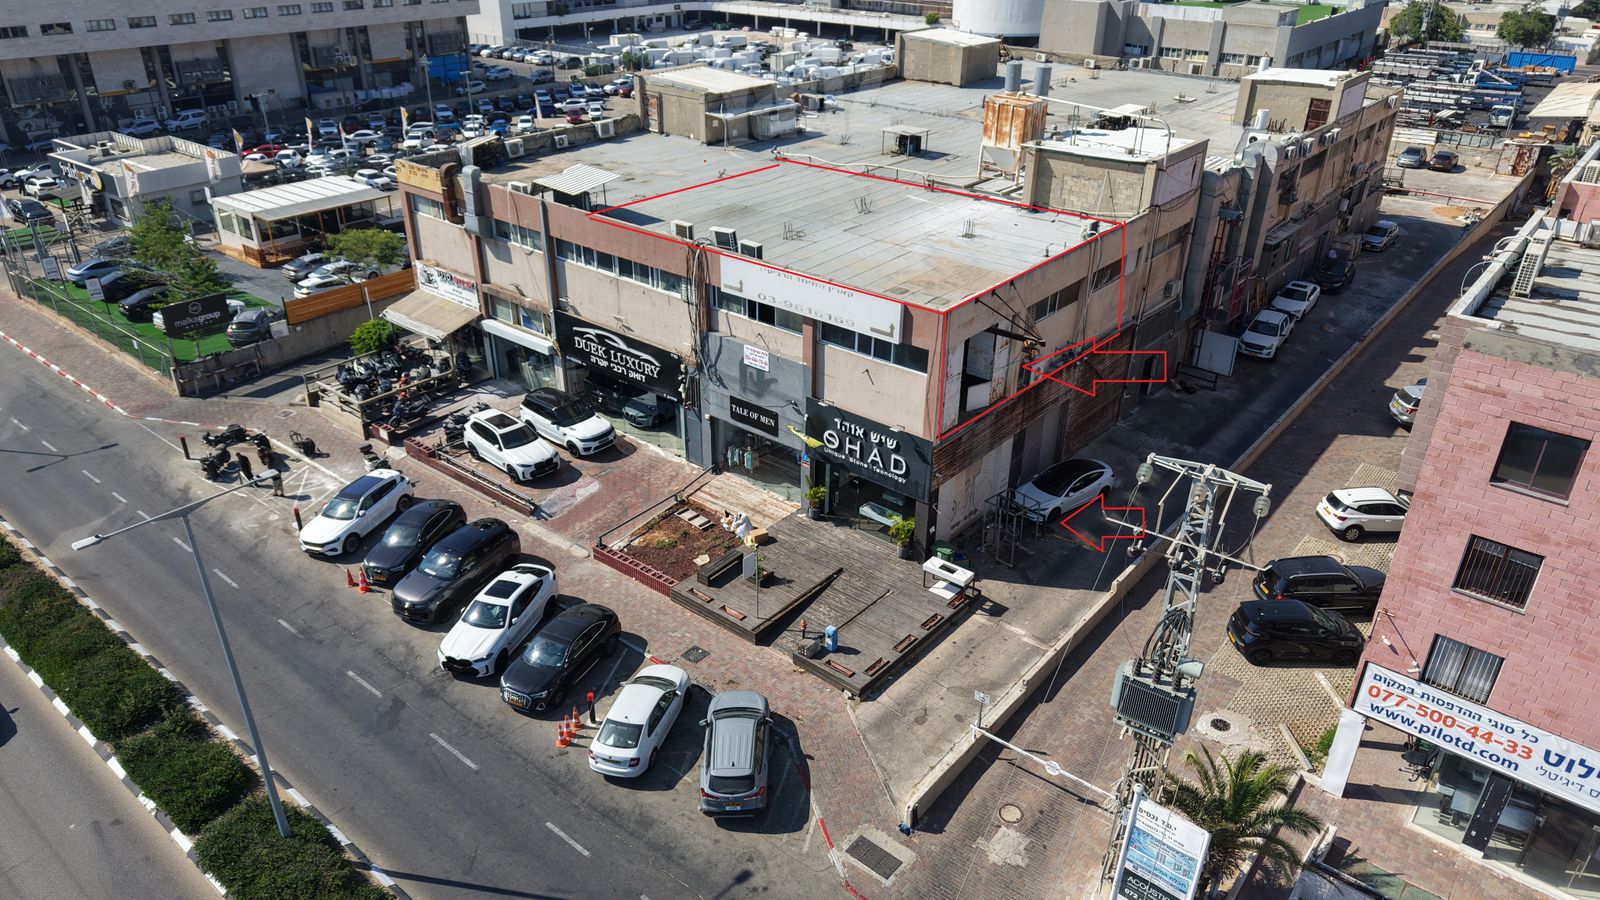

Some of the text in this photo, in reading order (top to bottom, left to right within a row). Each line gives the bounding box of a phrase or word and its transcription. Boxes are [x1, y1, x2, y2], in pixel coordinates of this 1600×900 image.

[573, 336, 608, 359] DUEK
[610, 350, 661, 378] LUXURY
[610, 363, 627, 375] רכבי
[731, 404, 775, 427] TALE OF MEN
[870, 431, 897, 449] שיש
[823, 447, 846, 460] Unique
[849, 457, 868, 468] Stone
[1373, 672, 1539, 744] כל סוגי ההדפסות במקום
[1367, 684, 1533, 760] 077-500-44-33
[1370, 702, 1520, 772] www.pilotd.com
[1535, 765, 1585, 792] דיגיטלי
[1138, 807, 1159, 822] נכסים
[1124, 888, 1138, 900] 072
